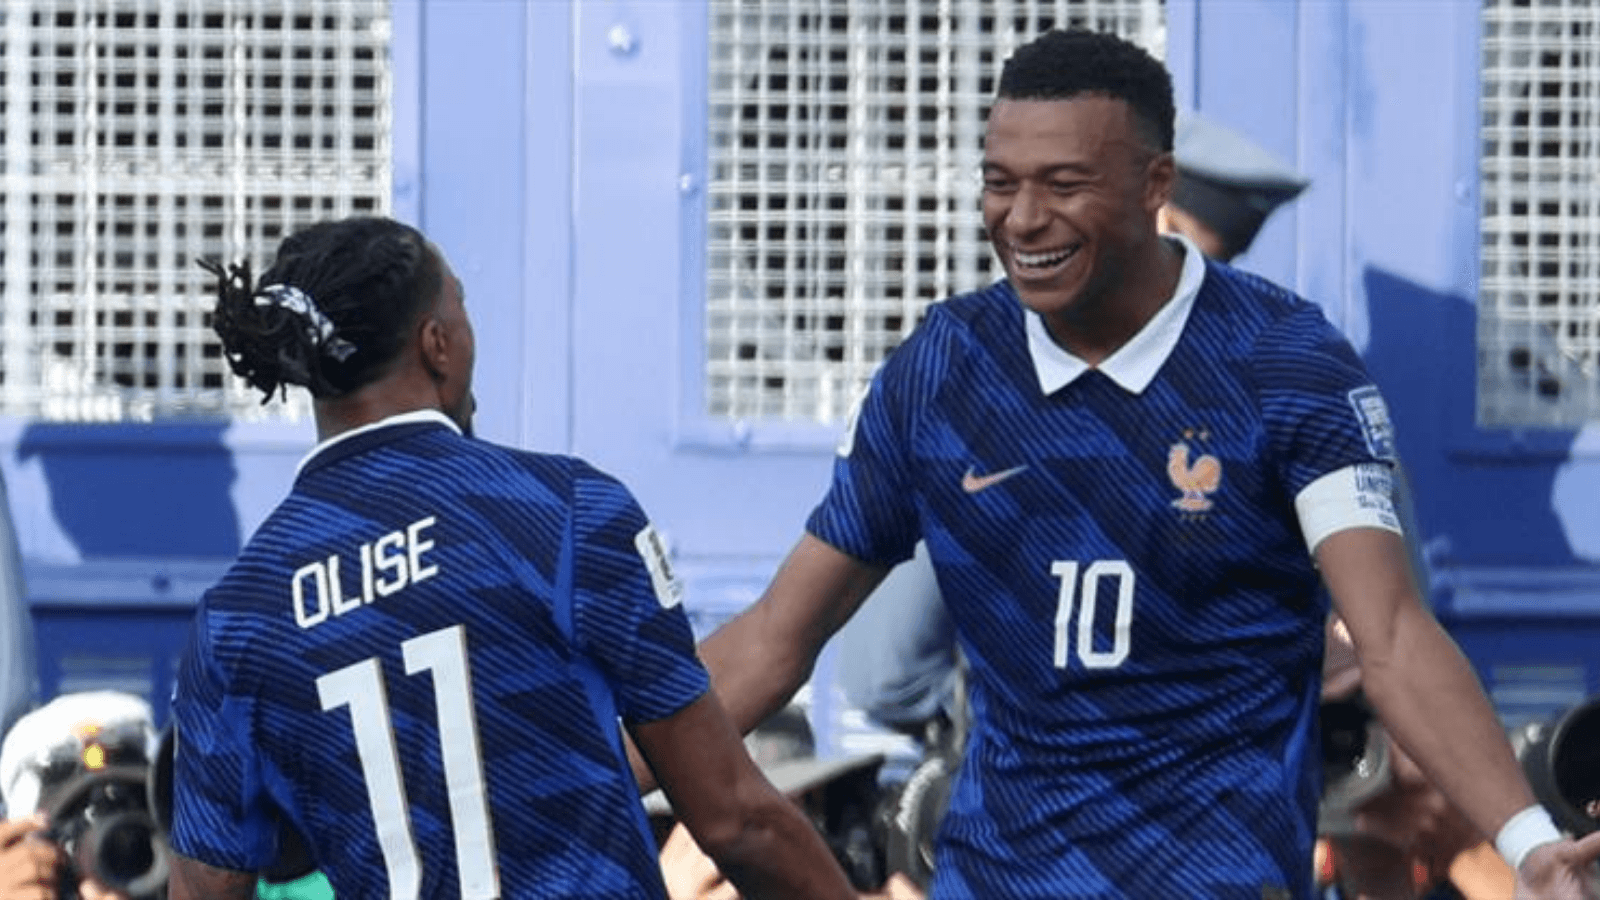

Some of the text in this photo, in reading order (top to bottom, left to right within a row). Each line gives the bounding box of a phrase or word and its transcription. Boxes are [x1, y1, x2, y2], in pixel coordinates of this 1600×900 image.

[292, 516, 438, 629] OLISE
[1051, 560, 1135, 668] 10
[316, 625, 500, 900] 11
